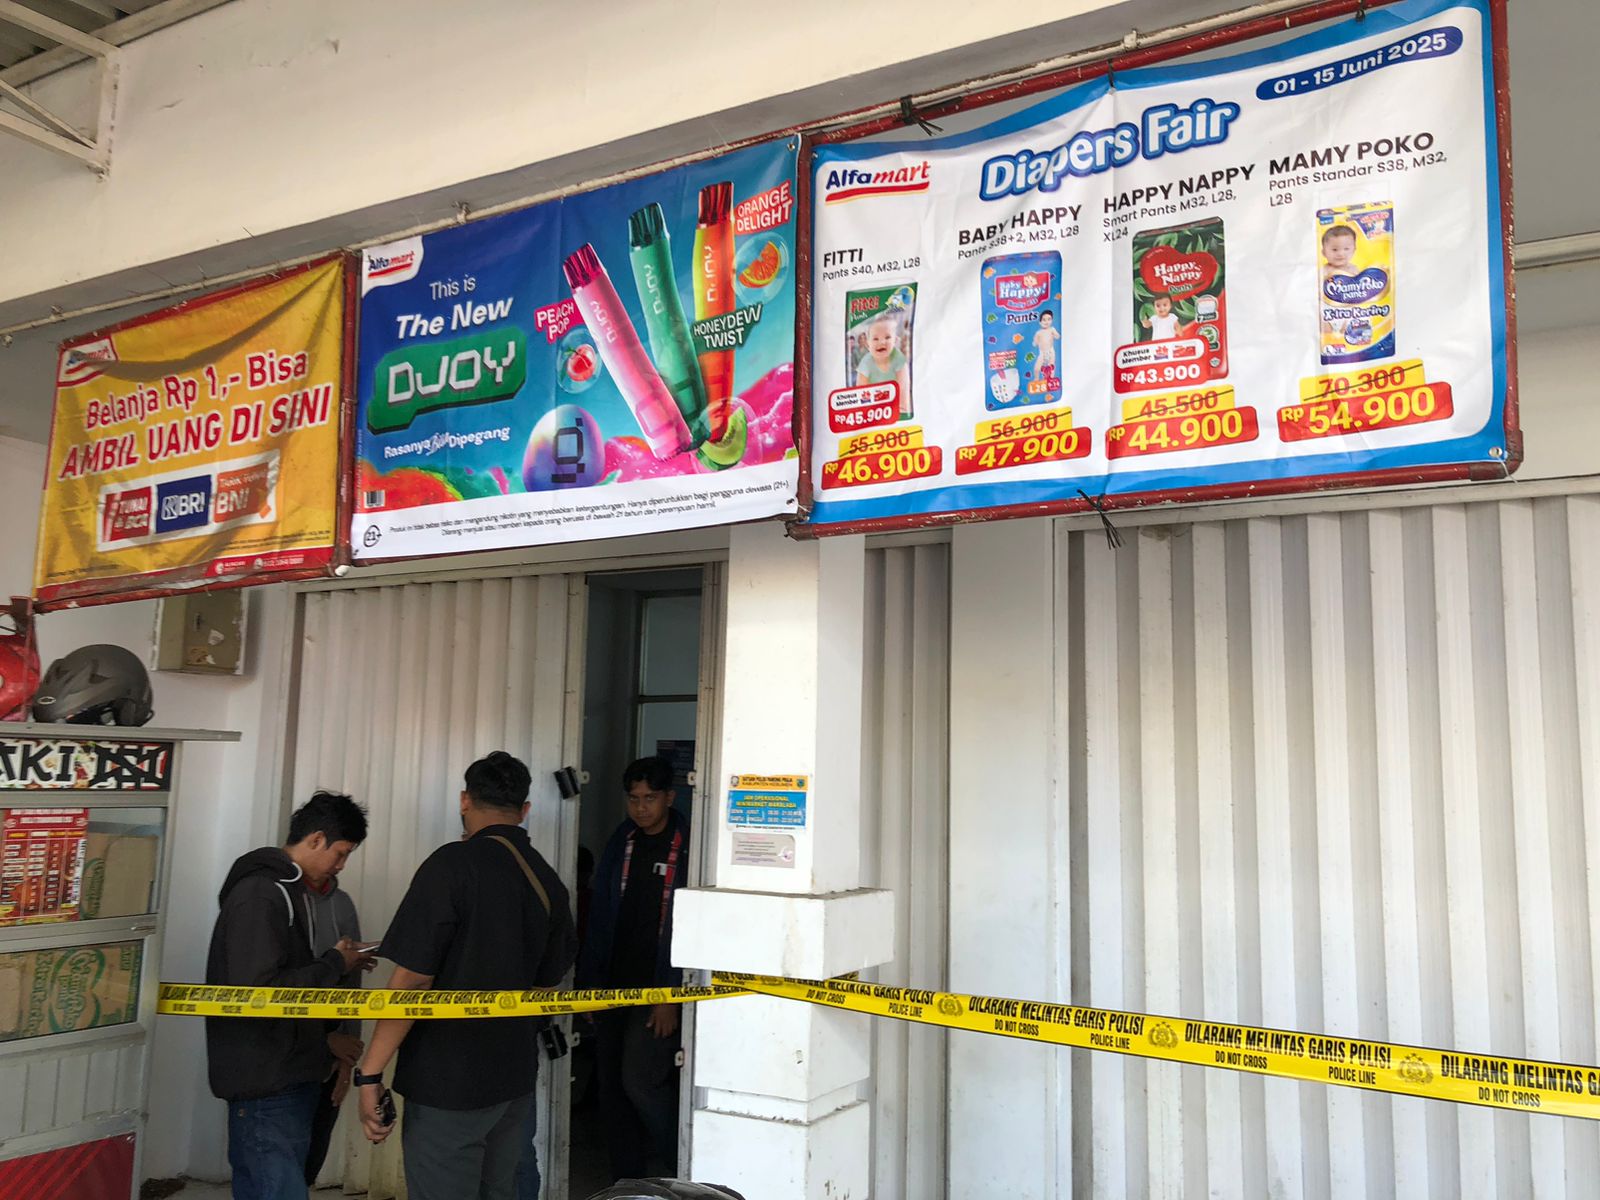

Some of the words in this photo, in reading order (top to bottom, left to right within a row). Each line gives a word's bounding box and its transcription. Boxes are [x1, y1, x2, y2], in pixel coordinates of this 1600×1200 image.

[1274, 78, 1296, 94] 01
[1313, 68, 1335, 84] 15
[1339, 51, 1383, 78] Juni
[1388, 33, 1447, 61] 2025
[982, 124, 1137, 199] Diapers
[1145, 101, 1237, 157] Fair
[1269, 144, 1350, 176] MAMY
[1357, 132, 1434, 160] POKO
[826, 161, 930, 191] Alfamart
[1269, 176, 1309, 191] Pants
[1313, 164, 1373, 183] Standar
[1377, 159, 1409, 173] S38,
[1413, 151, 1448, 169] M32,
[737, 183, 789, 217] ORANGE
[1104, 182, 1173, 214] HAPPY
[1179, 164, 1255, 197] NAPPY
[1270, 193, 1293, 207] L28
[737, 199, 793, 232] DELIGHT
[1103, 209, 1137, 229] Smart
[1140, 201, 1177, 218] Pants
[1180, 195, 1209, 212] M32,
[1211, 189, 1237, 203] L28,
[958, 220, 1009, 246] BABY
[1011, 205, 1083, 229] HAPPY
[1103, 226, 1129, 243] XL24
[958, 244, 988, 260] Pants
[989, 233, 1026, 250] S38+2,
[1029, 229, 1058, 242] M32,
[1060, 225, 1080, 239] L28
[368, 250, 415, 271] Alfamart
[823, 268, 849, 281] Pants
[851, 264, 874, 277] S40,
[877, 260, 901, 272] M32,
[903, 257, 921, 269] L28
[824, 248, 864, 268] FITTI
[1153, 262, 1202, 277] Happy
[430, 278, 460, 300] This
[463, 274, 476, 292] is
[1000, 282, 1048, 299] Happy!
[1161, 271, 1203, 287] Nappy
[397, 313, 444, 339] The
[451, 297, 514, 330] New
[537, 302, 575, 328] PEACH
[549, 317, 571, 340] POP
[694, 304, 763, 336] HONEYDEW
[1006, 312, 1038, 324] Pants
[703, 328, 746, 348] TWIST
[388, 341, 516, 403] DJOY
[1319, 365, 1405, 398] 70.300
[87, 389, 159, 429] Belanja
[165, 375, 197, 411] Rp
[205, 366, 241, 398] 1,-
[248, 352, 308, 390] Bisa
[1140, 390, 1219, 418] 45.500
[1281, 408, 1304, 423] Rp
[1309, 387, 1436, 434] 54.900
[59, 433, 139, 480] AMBIL
[148, 412, 222, 461] UANG
[230, 404, 261, 443] DI
[269, 385, 332, 435] SINI
[990, 412, 1058, 439] 56.900
[1108, 426, 1126, 442] Rp
[1128, 410, 1243, 451] 44.900
[384, 440, 431, 459] Rasanya
[448, 427, 511, 448] Dipegang
[849, 430, 910, 454] 55.900
[959, 446, 977, 463] Rp
[978, 431, 1079, 468] 47.900
[825, 461, 838, 475] Rp
[838, 449, 931, 483] 46.900
[179, 492, 206, 516] BRI
[806, 989, 815, 999] DO
[816, 990, 827, 1001] NOT
[827, 993, 846, 1005] CROSS
[874, 986, 900, 1000] GARIS
[903, 988, 936, 1005] POLISI
[888, 1002, 908, 1016] POLICE
[909, 1006, 924, 1018] LINE
[968, 996, 1018, 1018] DILARANG
[1020, 1003, 1071, 1026] MELINTAS
[1074, 1009, 1107, 1031] GARIS
[1109, 1014, 1146, 1036] POLISI
[994, 1019, 1004, 1031] DO
[1005, 1021, 1017, 1033] NOT
[1018, 1023, 1040, 1037] CROSS
[1090, 1033, 1114, 1048] POLICE
[1115, 1036, 1131, 1050] LINE
[1185, 1023, 1243, 1049] DILARANG
[1245, 1030, 1305, 1058] MELINTAS
[1308, 1038, 1346, 1064] GARIS
[1349, 1043, 1392, 1070] POLISI
[1215, 1051, 1226, 1063] DO
[1227, 1052, 1243, 1067] NOT
[1243, 1055, 1268, 1070] CROSS
[1441, 1054, 1509, 1085] DILARANG
[1513, 1063, 1583, 1095] MELINTAS
[1328, 1066, 1357, 1083] POLICE
[1358, 1070, 1377, 1085] LINE
[1478, 1087, 1490, 1101] DO
[1493, 1089, 1509, 1104] NOT
[1511, 1091, 1541, 1108] CROSS
